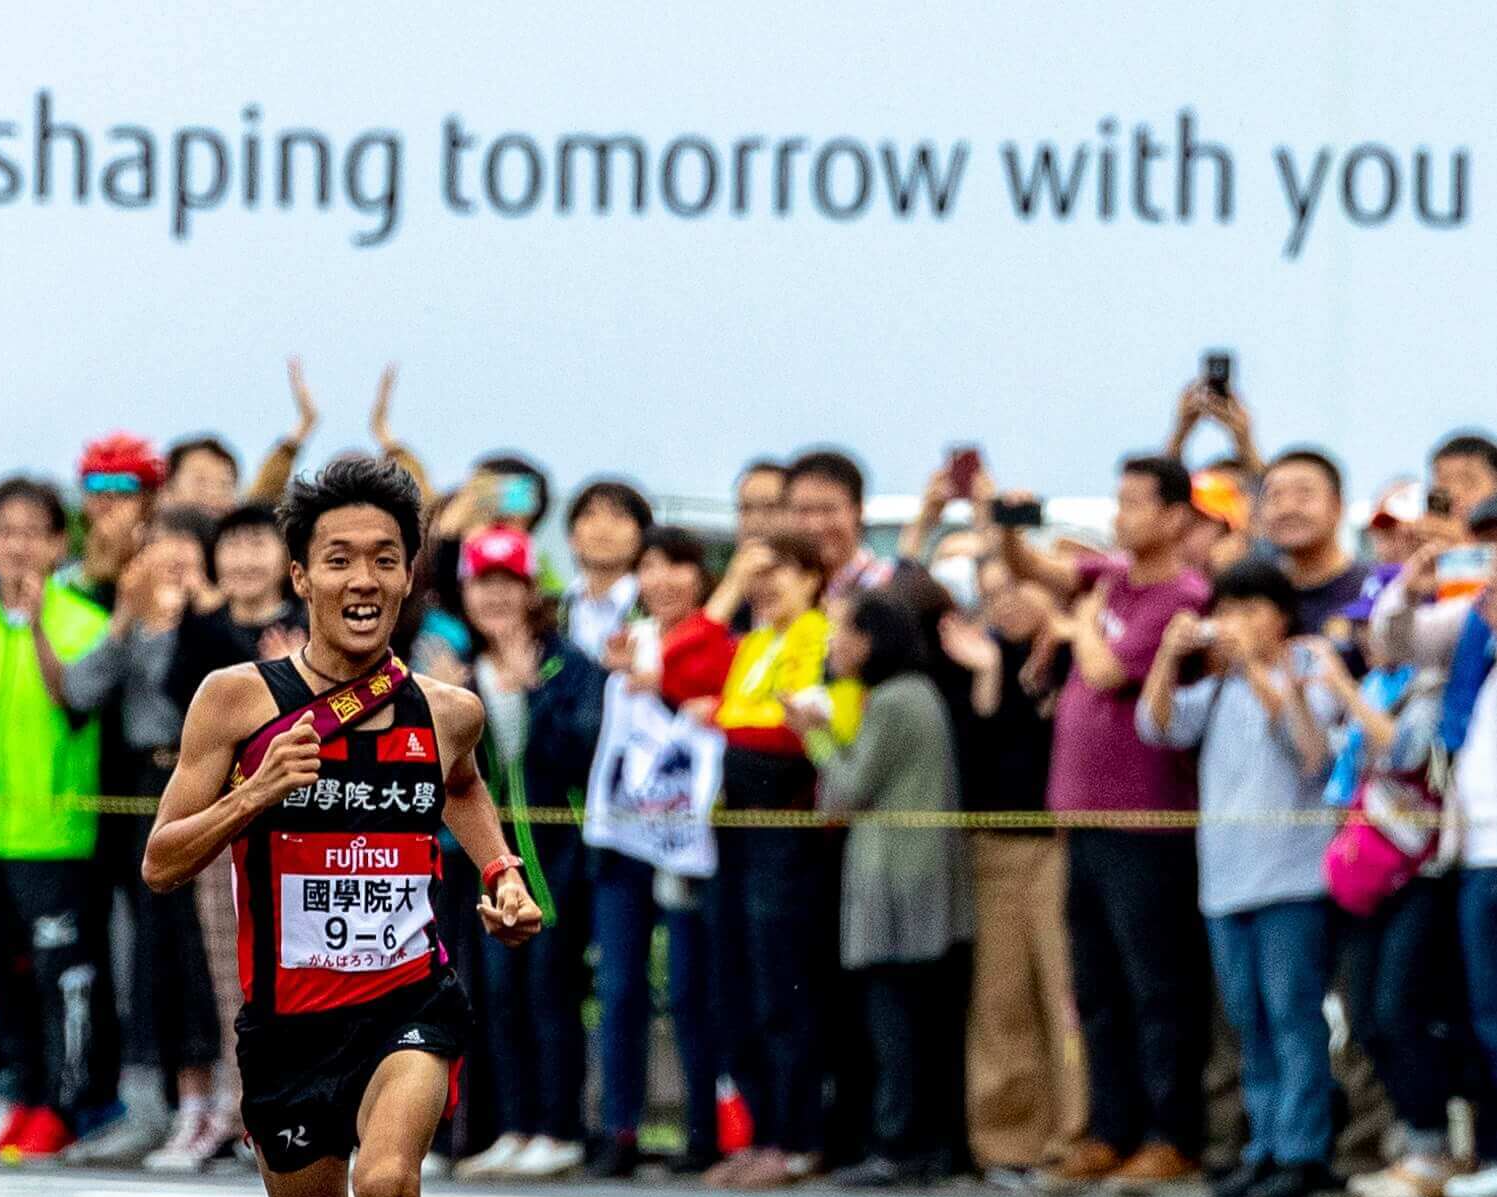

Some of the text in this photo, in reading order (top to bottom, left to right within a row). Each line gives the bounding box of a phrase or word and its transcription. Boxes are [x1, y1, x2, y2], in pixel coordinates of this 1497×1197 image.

[439, 113, 968, 220] tomorrow
[999, 106, 1235, 224] with
[1273, 143, 1469, 261] you
[283, 778, 436, 813] 國學院大學
[325, 837, 399, 873] FUJITSU
[303, 879, 417, 913] 國學院大
